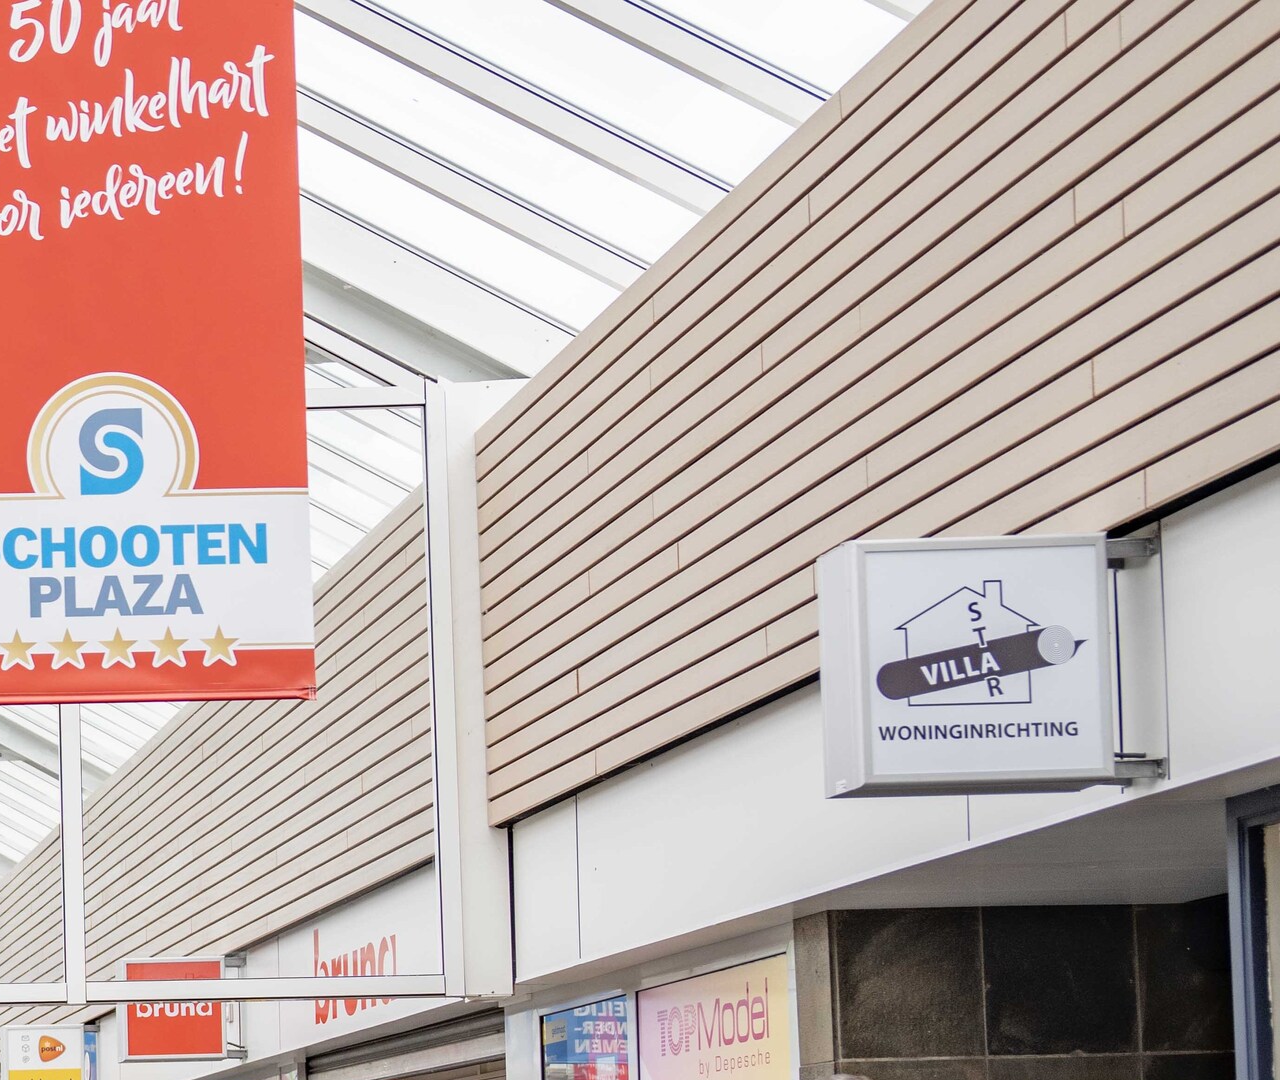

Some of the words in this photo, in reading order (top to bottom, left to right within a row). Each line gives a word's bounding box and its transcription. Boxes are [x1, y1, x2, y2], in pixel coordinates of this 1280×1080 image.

[8, 0, 81, 62] 50
[94, 0, 183, 67] jaar
[46, 45, 274, 142] winkelhart
[59, 131, 248, 229] iedereen!
[29, 574, 204, 618] PLAZA
[921, 652, 1000, 686] VILLA
[878, 721, 1078, 741] WONINGINRICHTING
[657, 977, 770, 1057] TOPModel
[40, 1043, 64, 1053] postnl
[699, 1062, 710, 1078] by
[715, 1049, 771, 1074] Depesche
